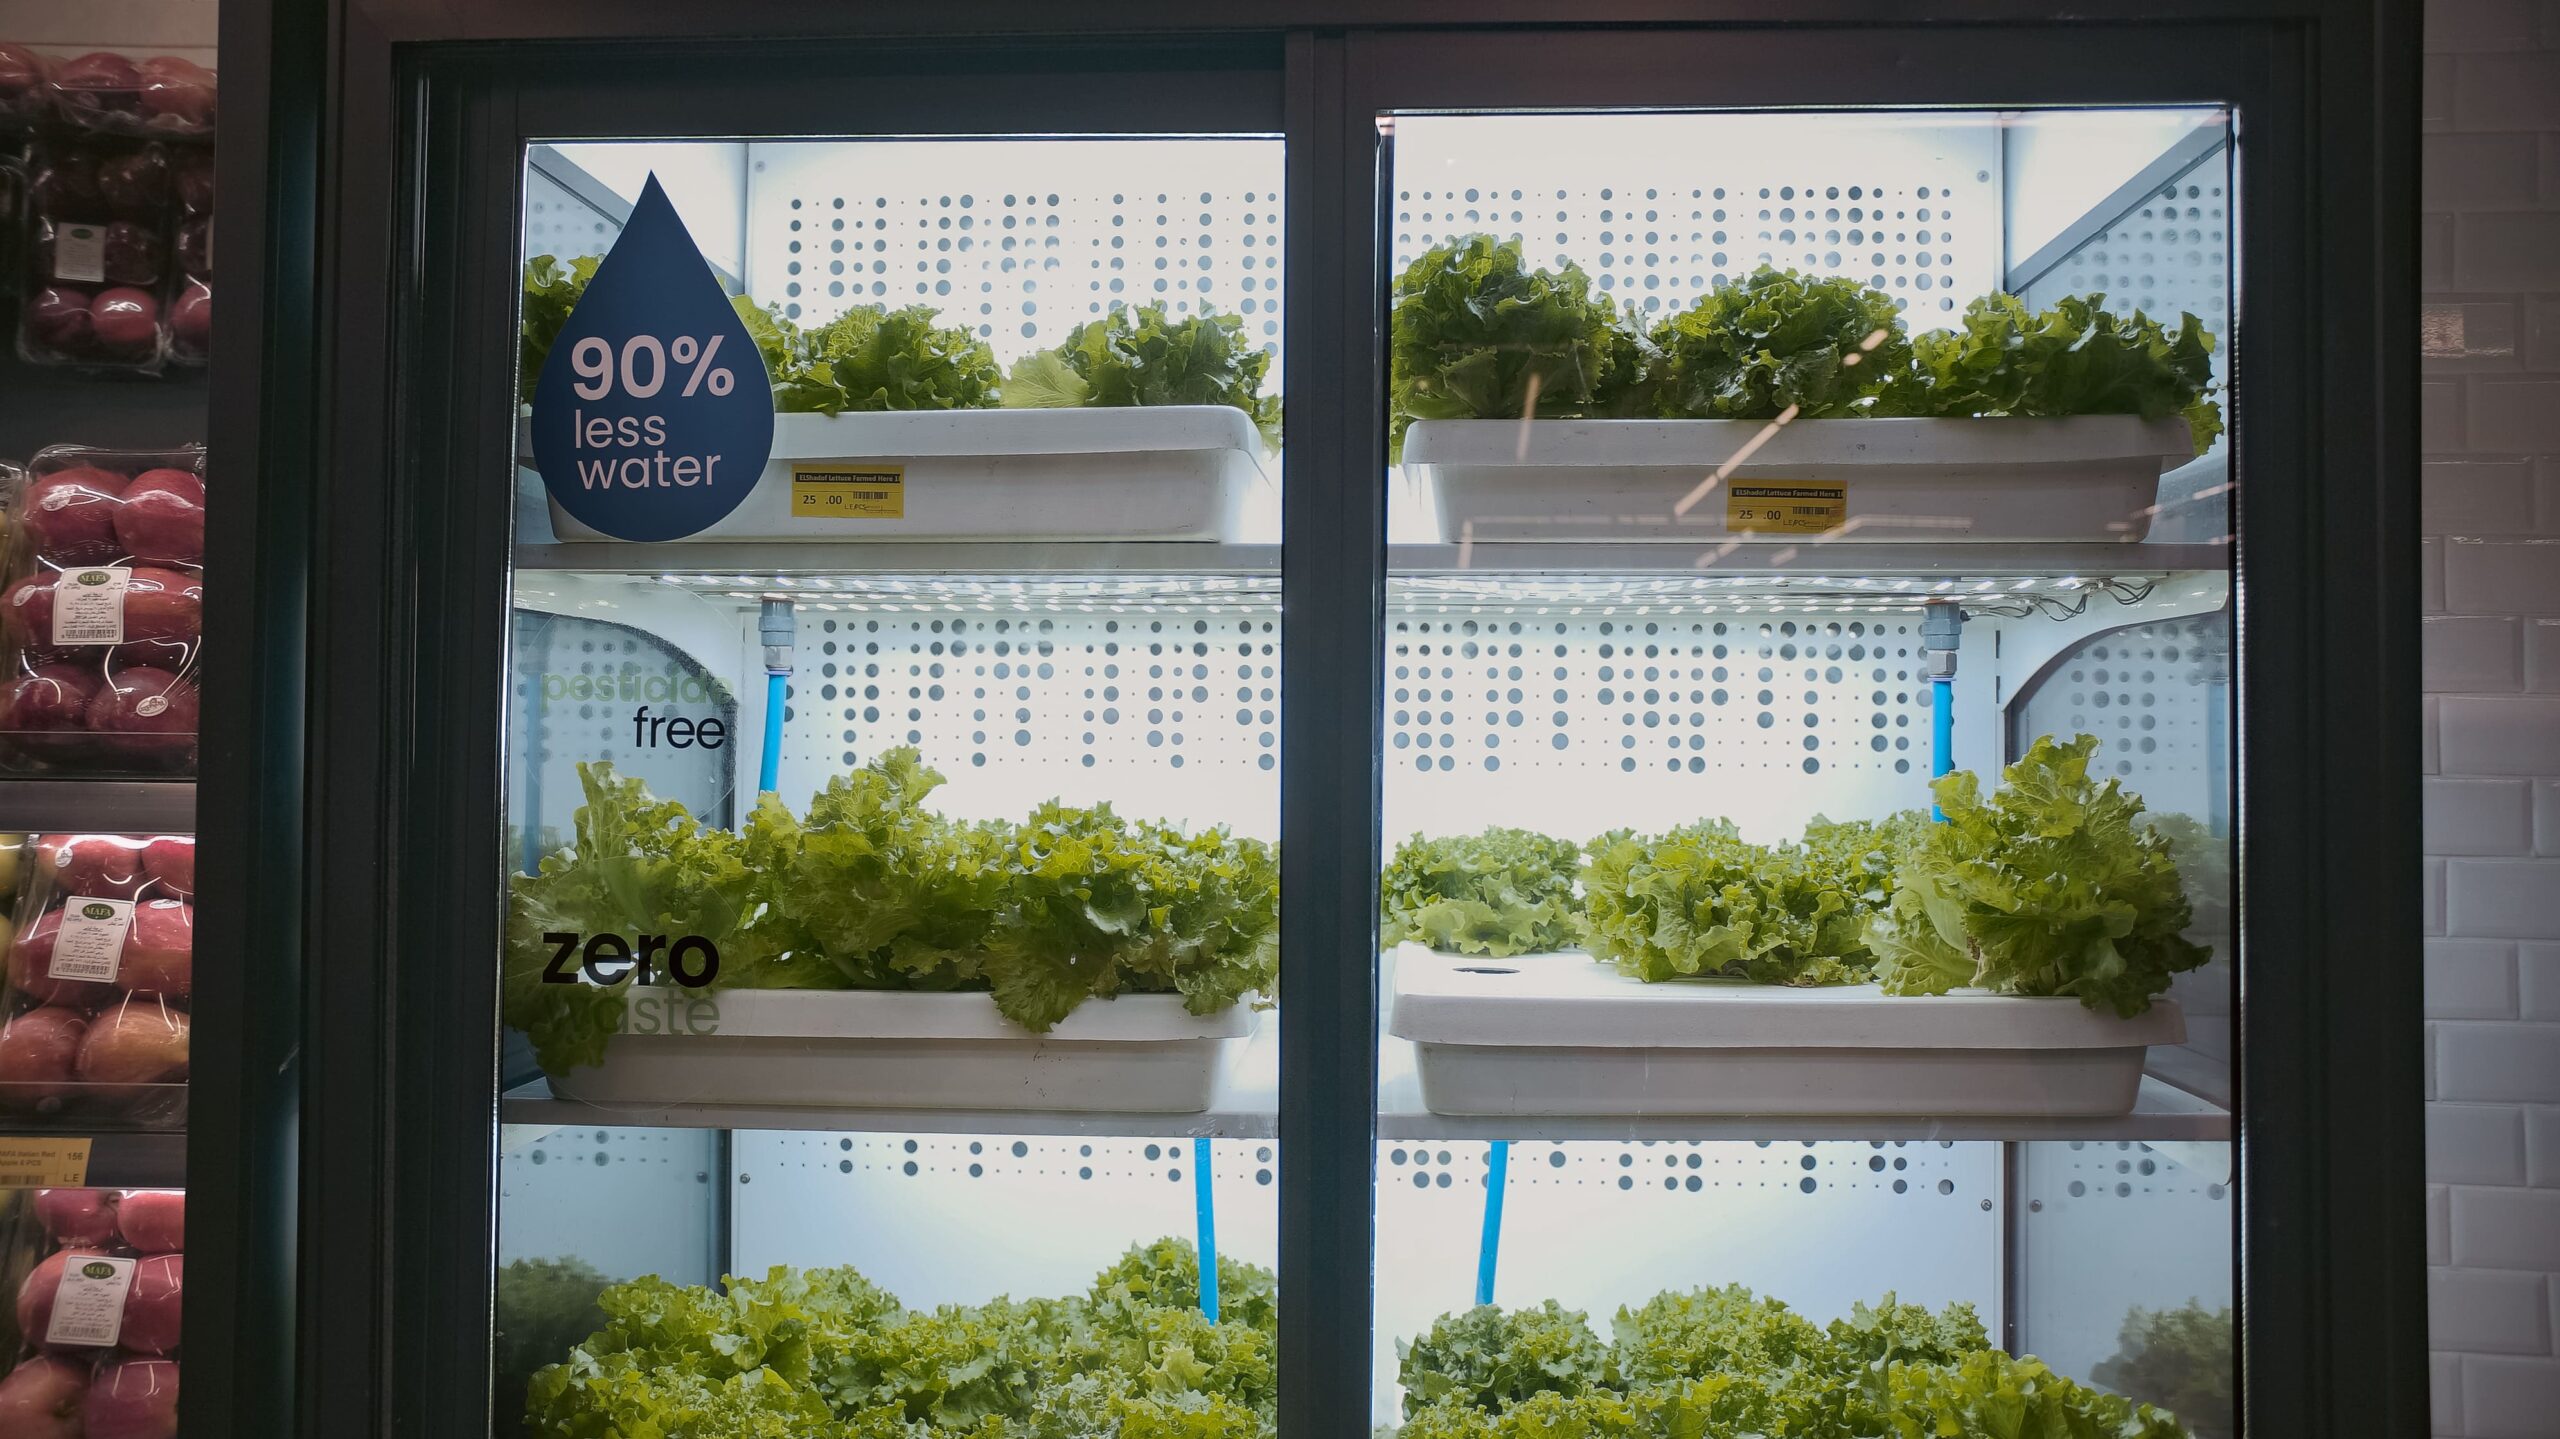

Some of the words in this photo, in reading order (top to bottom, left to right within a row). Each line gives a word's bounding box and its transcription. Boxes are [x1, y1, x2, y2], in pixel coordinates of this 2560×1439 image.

[570, 334, 735, 400] 90%
[575, 409, 666, 449] less
[577, 450, 721, 490] water
[828, 474, 852, 482] Lettuce
[853, 474, 877, 483] Farmed
[878, 475, 893, 483] Here
[1767, 489, 1791, 497] Lettuce
[1792, 490, 1818, 498] Farmed
[1820, 490, 1836, 498] Here
[803, 495, 816, 504] 25
[1739, 510, 1753, 519] 25
[80, 574, 107, 582] MAFA
[633, 706, 725, 749] free
[84, 906, 111, 916] MAFA
[542, 932, 720, 988] zero
[84, 1265, 112, 1275] MAFA
